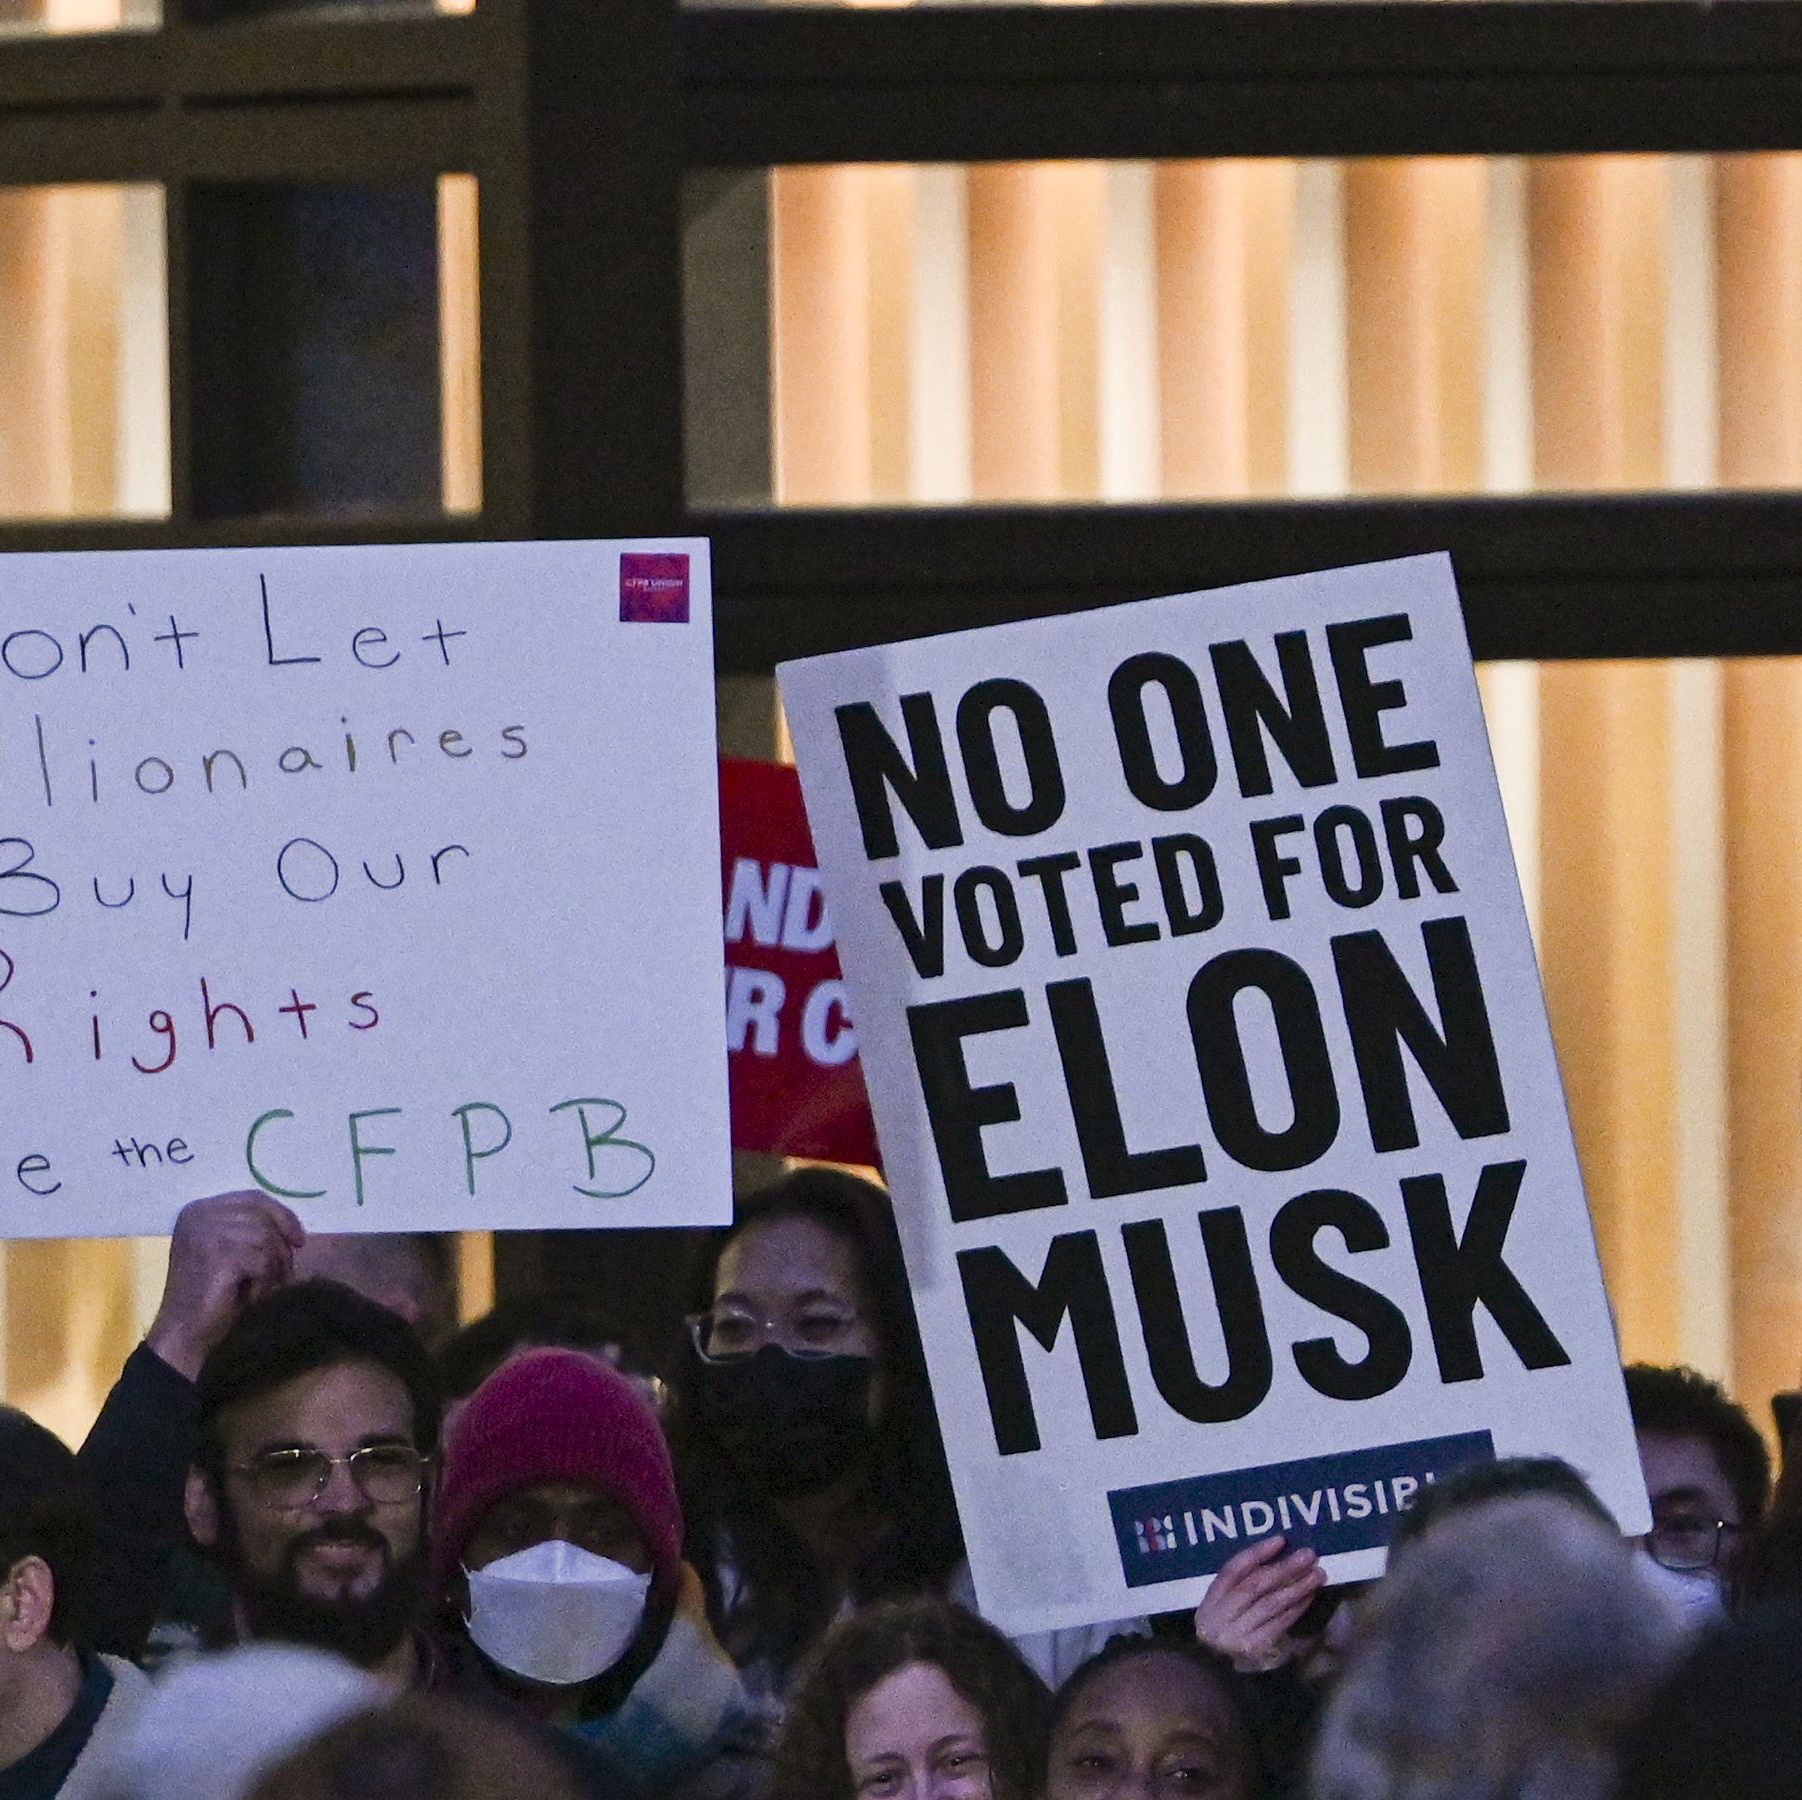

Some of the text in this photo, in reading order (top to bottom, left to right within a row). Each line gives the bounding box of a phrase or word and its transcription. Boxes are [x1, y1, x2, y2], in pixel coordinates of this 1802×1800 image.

[259, 573, 468, 669] Let
[834, 612, 1440, 860] NO ONE
[278, 835, 471, 904] Our
[878, 795, 1458, 979] VOTED FOR
[905, 915, 1509, 1223] ELON
[112, 1133, 195, 1169] the
[246, 1098, 657, 1205] CFPB
[954, 1159, 1570, 1456] MUSK
[1184, 1472, 1437, 1547] INDIVISIB
